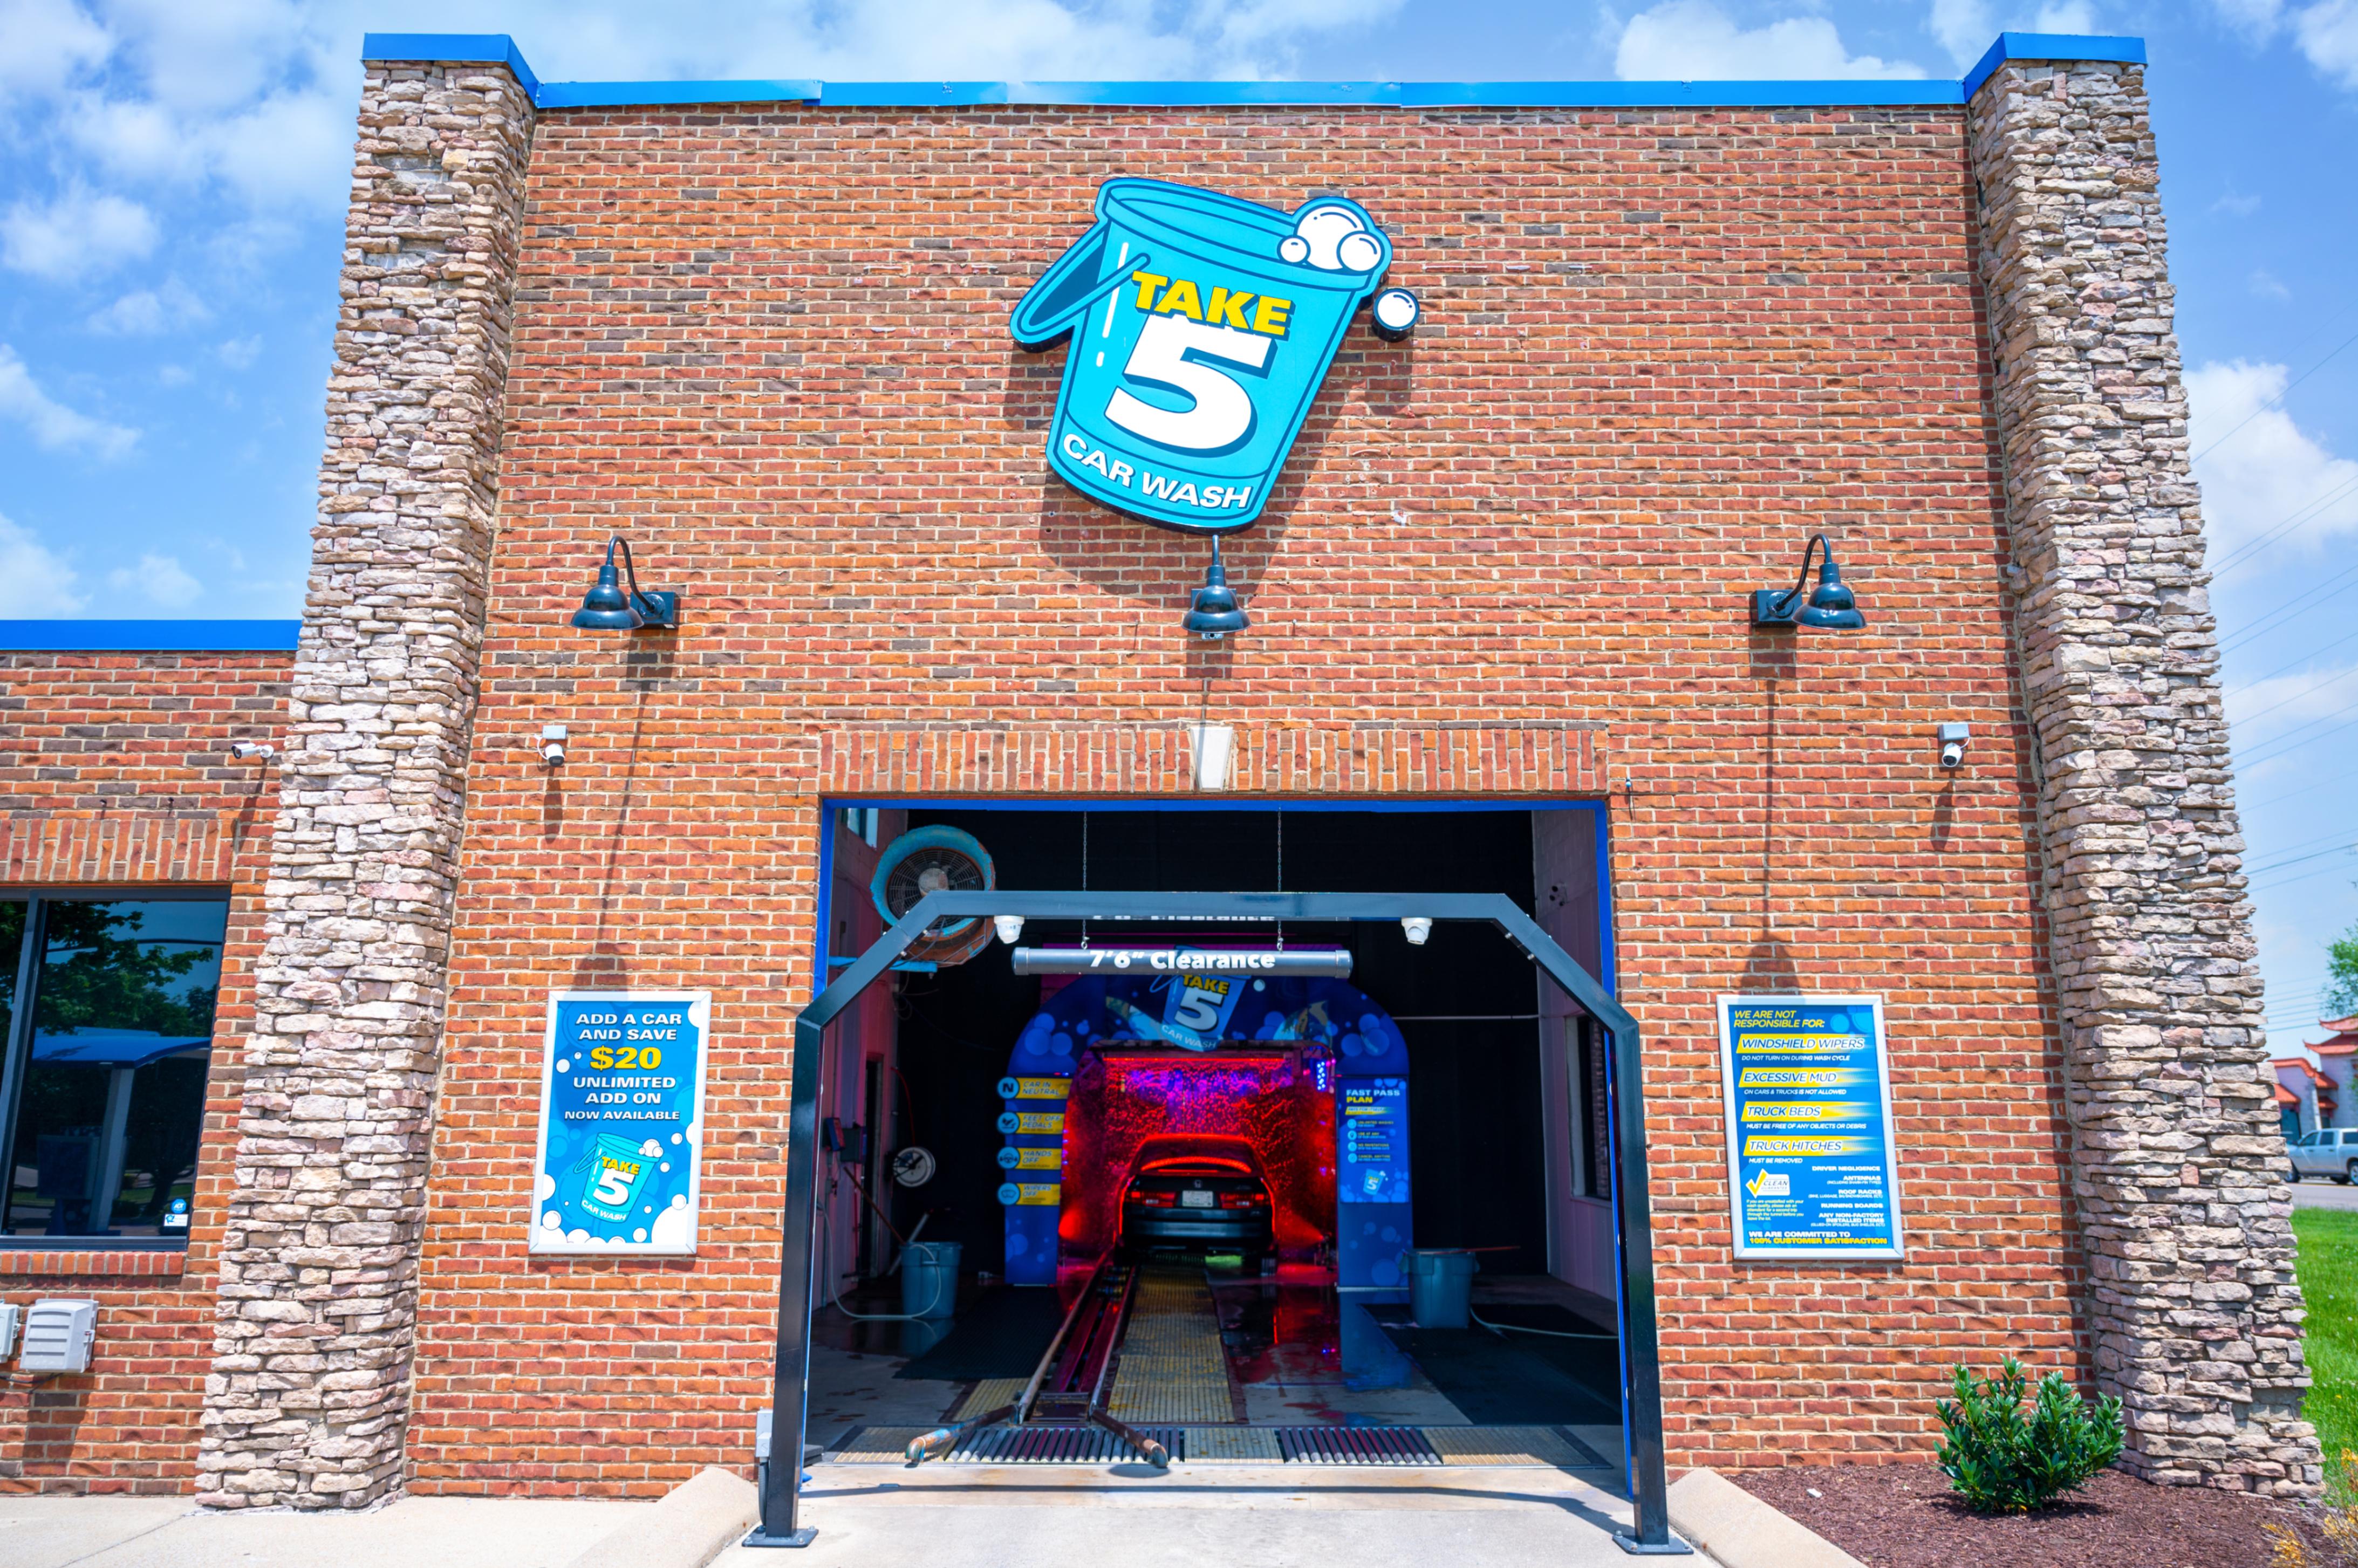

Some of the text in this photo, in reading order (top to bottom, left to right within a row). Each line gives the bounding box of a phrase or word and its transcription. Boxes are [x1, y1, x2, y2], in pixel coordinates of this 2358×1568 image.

[1132, 271, 1293, 337] TAKE
[1104, 314, 1273, 449] 5
[1063, 433, 1253, 509] CAR WASH
[1089, 950, 1276, 969] 7'6" Clearance
[1182, 974, 1229, 994] TAKE
[1174, 988, 1224, 1031] 5
[1734, 1010, 1797, 1018] WE ARE NOT
[576, 1014, 682, 1024] ADD A CAR
[1734, 1019, 1826, 1028] RESPONSIBLE FOR:
[579, 1029, 677, 1040] AND SAVE
[1162, 1025, 1217, 1049] CAR WASH
[1742, 1039, 1864, 1049] WINDSHIELD WIPERS
[590, 1045, 661, 1071] $20
[573, 1077, 676, 1088] UNLIMITED
[1744, 1072, 1836, 1082] EXCESSIVE MUD
[1003, 1083, 1014, 1093] N
[585, 1093, 661, 1104] ADD ON
[565, 1111, 680, 1120] NOW AVAILABLE
[1747, 1107, 1821, 1116] TRUCK BEDS
[1750, 1141, 1842, 1151] TRUCK HITCHES
[602, 1156, 641, 1175] TAKE
[593, 1167, 635, 1205] 5
[1366, 1179, 1378, 1190] 5
[582, 1200, 626, 1221] CAR WASH
